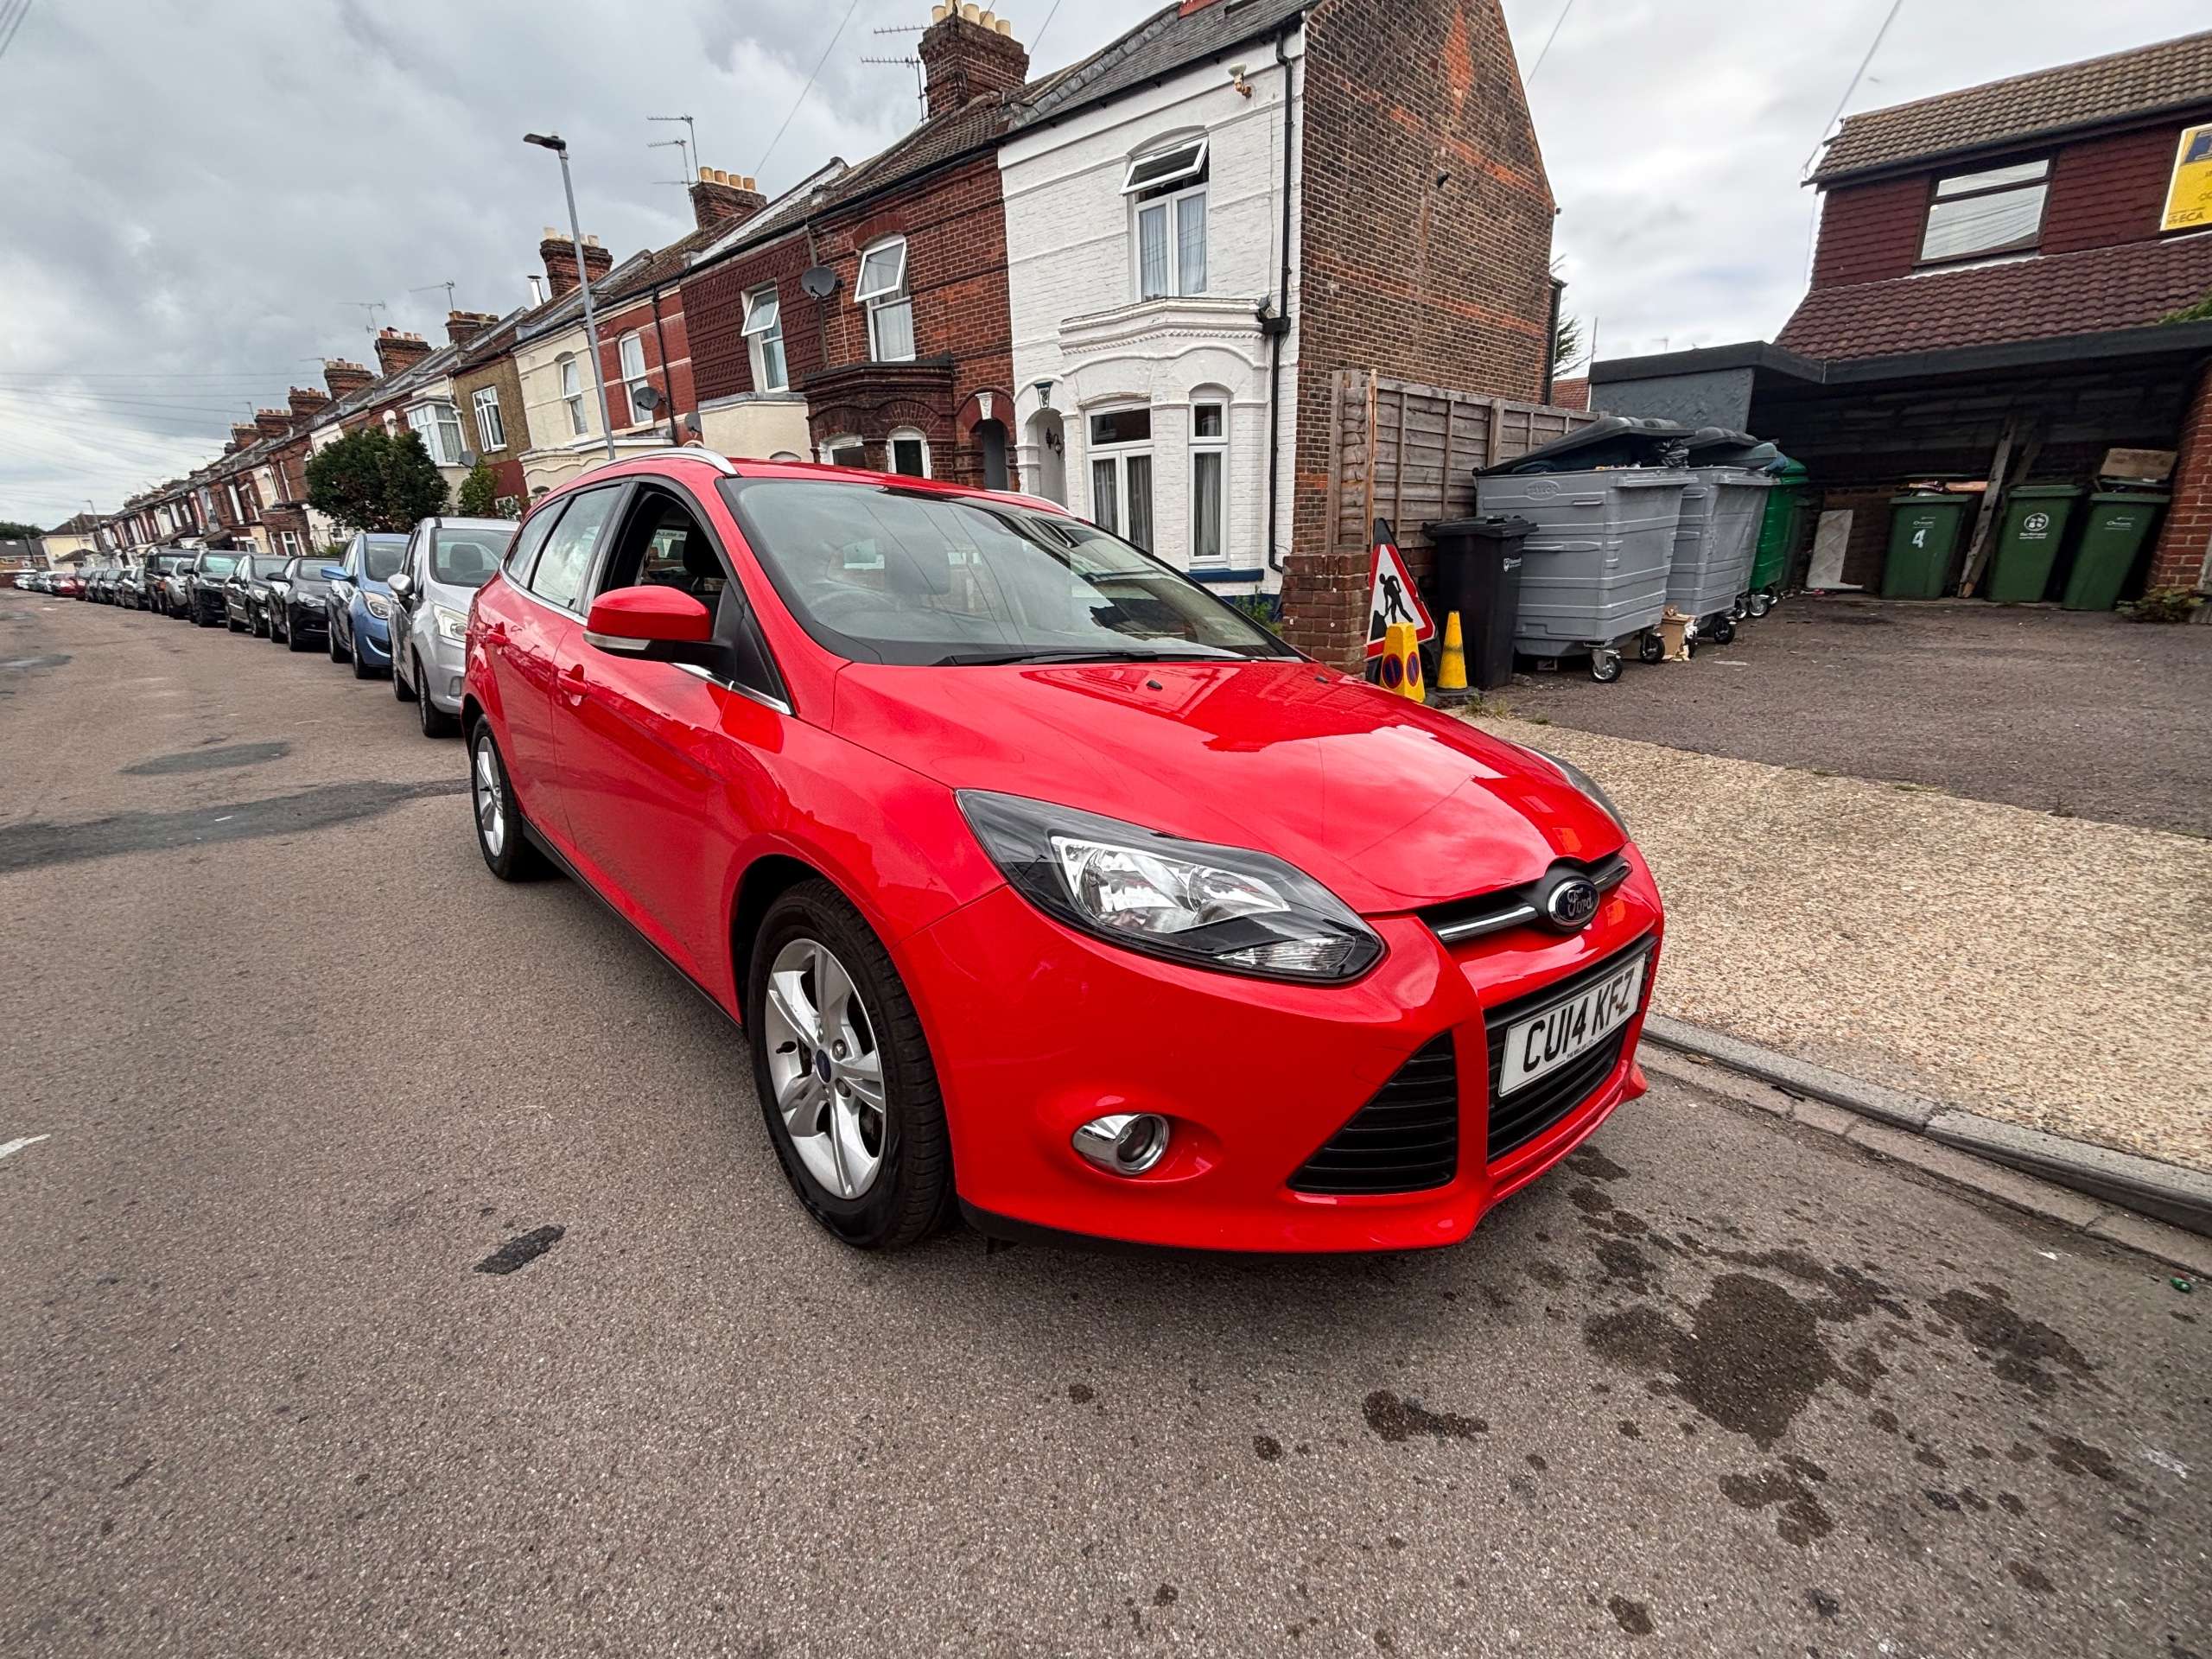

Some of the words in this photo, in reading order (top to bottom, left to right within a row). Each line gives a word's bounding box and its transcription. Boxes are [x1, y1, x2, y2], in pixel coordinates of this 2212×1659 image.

[1912, 529, 1926, 548] 4
[1567, 887, 1593, 916] Ford
[1522, 996, 1589, 1073] CU14
[1592, 966, 1636, 1036] KFZ
